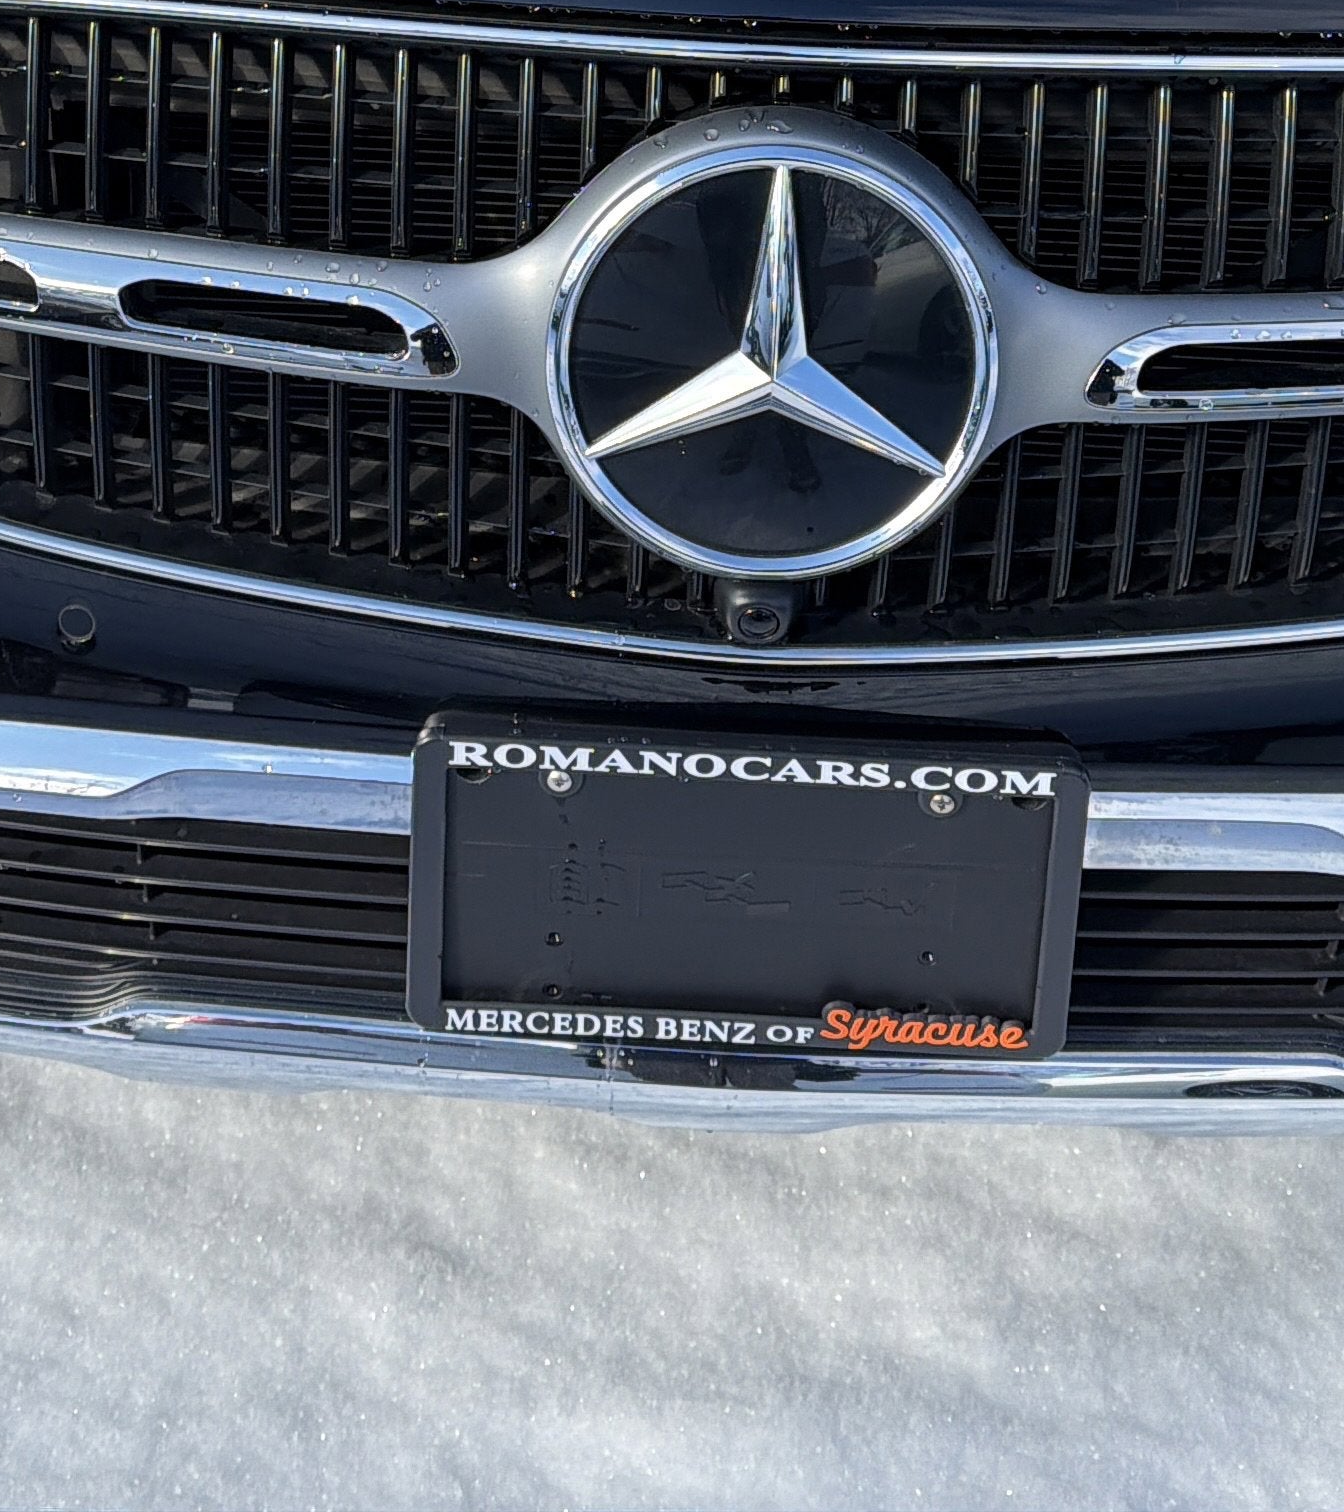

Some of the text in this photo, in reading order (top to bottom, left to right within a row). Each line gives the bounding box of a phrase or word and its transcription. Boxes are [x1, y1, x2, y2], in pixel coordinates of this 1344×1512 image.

[449, 741, 1056, 796] ROMANOCARS.COM
[446, 1009, 1029, 1050] MERCEDES BENZ OF Syracuse
